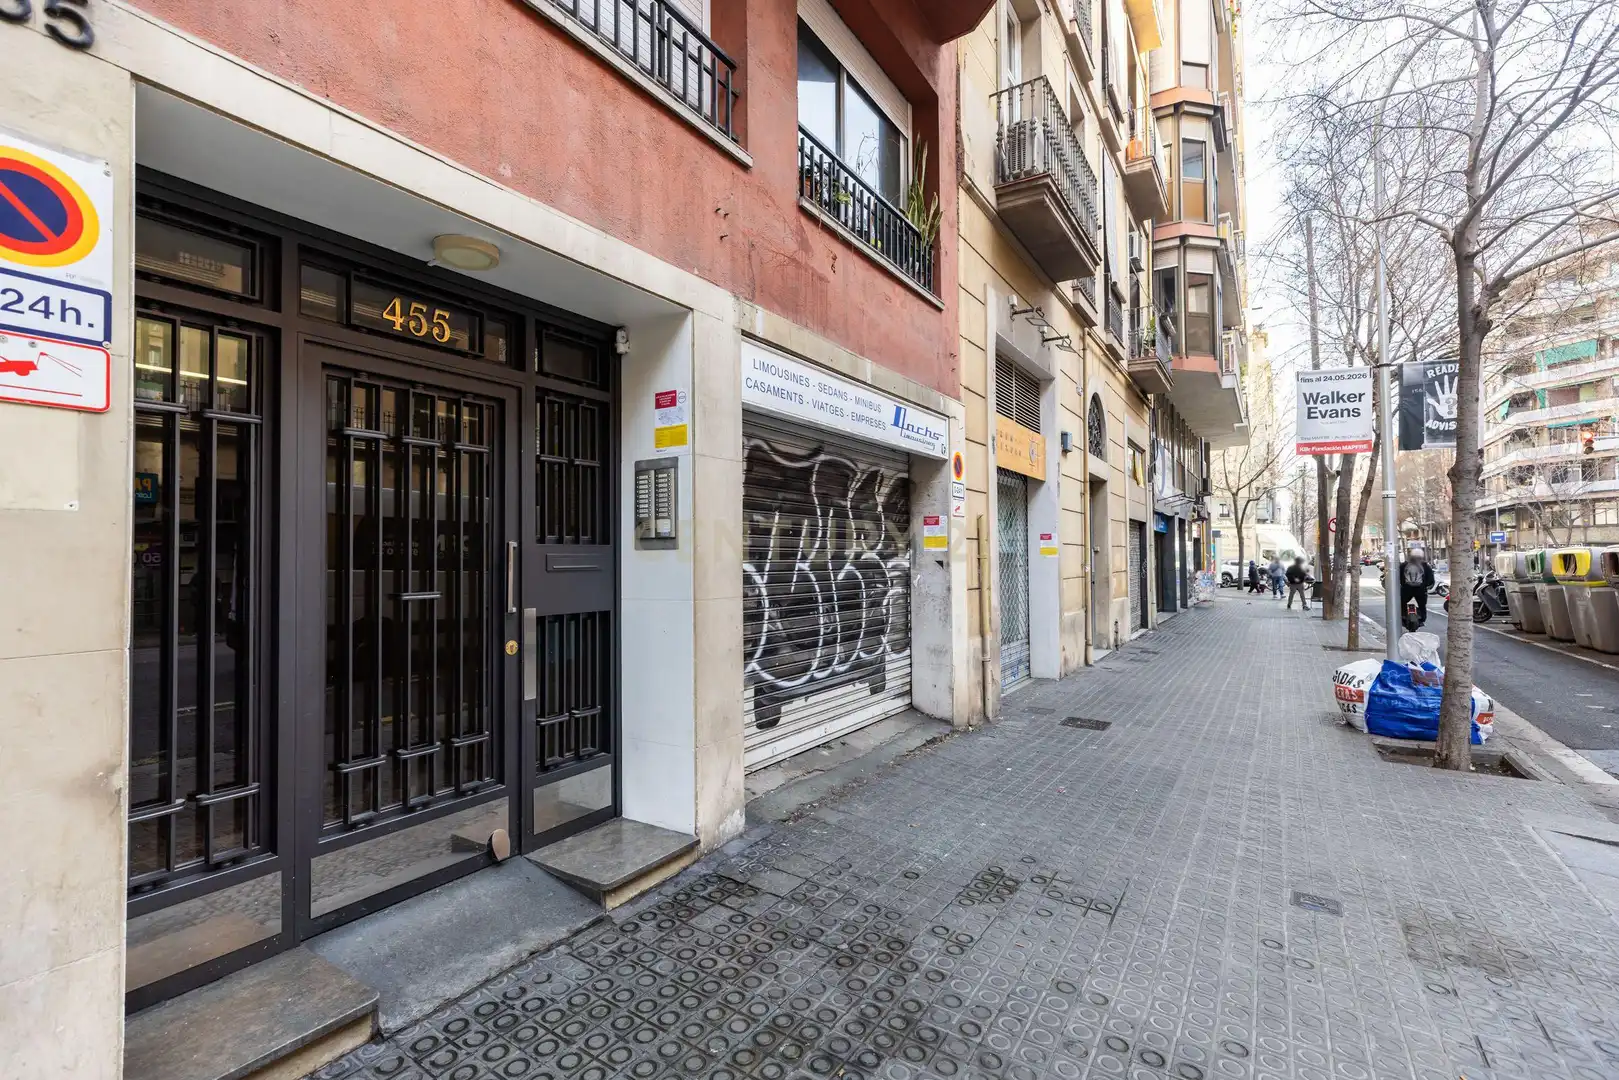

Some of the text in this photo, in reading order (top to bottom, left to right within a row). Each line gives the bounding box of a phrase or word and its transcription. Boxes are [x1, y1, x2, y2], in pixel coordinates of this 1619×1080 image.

[382, 297, 451, 343] 455
[753, 358, 811, 388] LIMOUSINES
[817, 382, 849, 402] SEDANS
[854, 395, 882, 413] MINIBUS
[1300, 372, 1368, 384] fins al 24.05.2026
[745, 377, 804, 405] CASAMENTS
[811, 398, 845, 418] VIATGES
[850, 411, 887, 431] EMPRESES
[1302, 390, 1366, 406] Walker
[1306, 406, 1362, 420] Evans
[1342, 443, 1369, 451] MAPFRE
